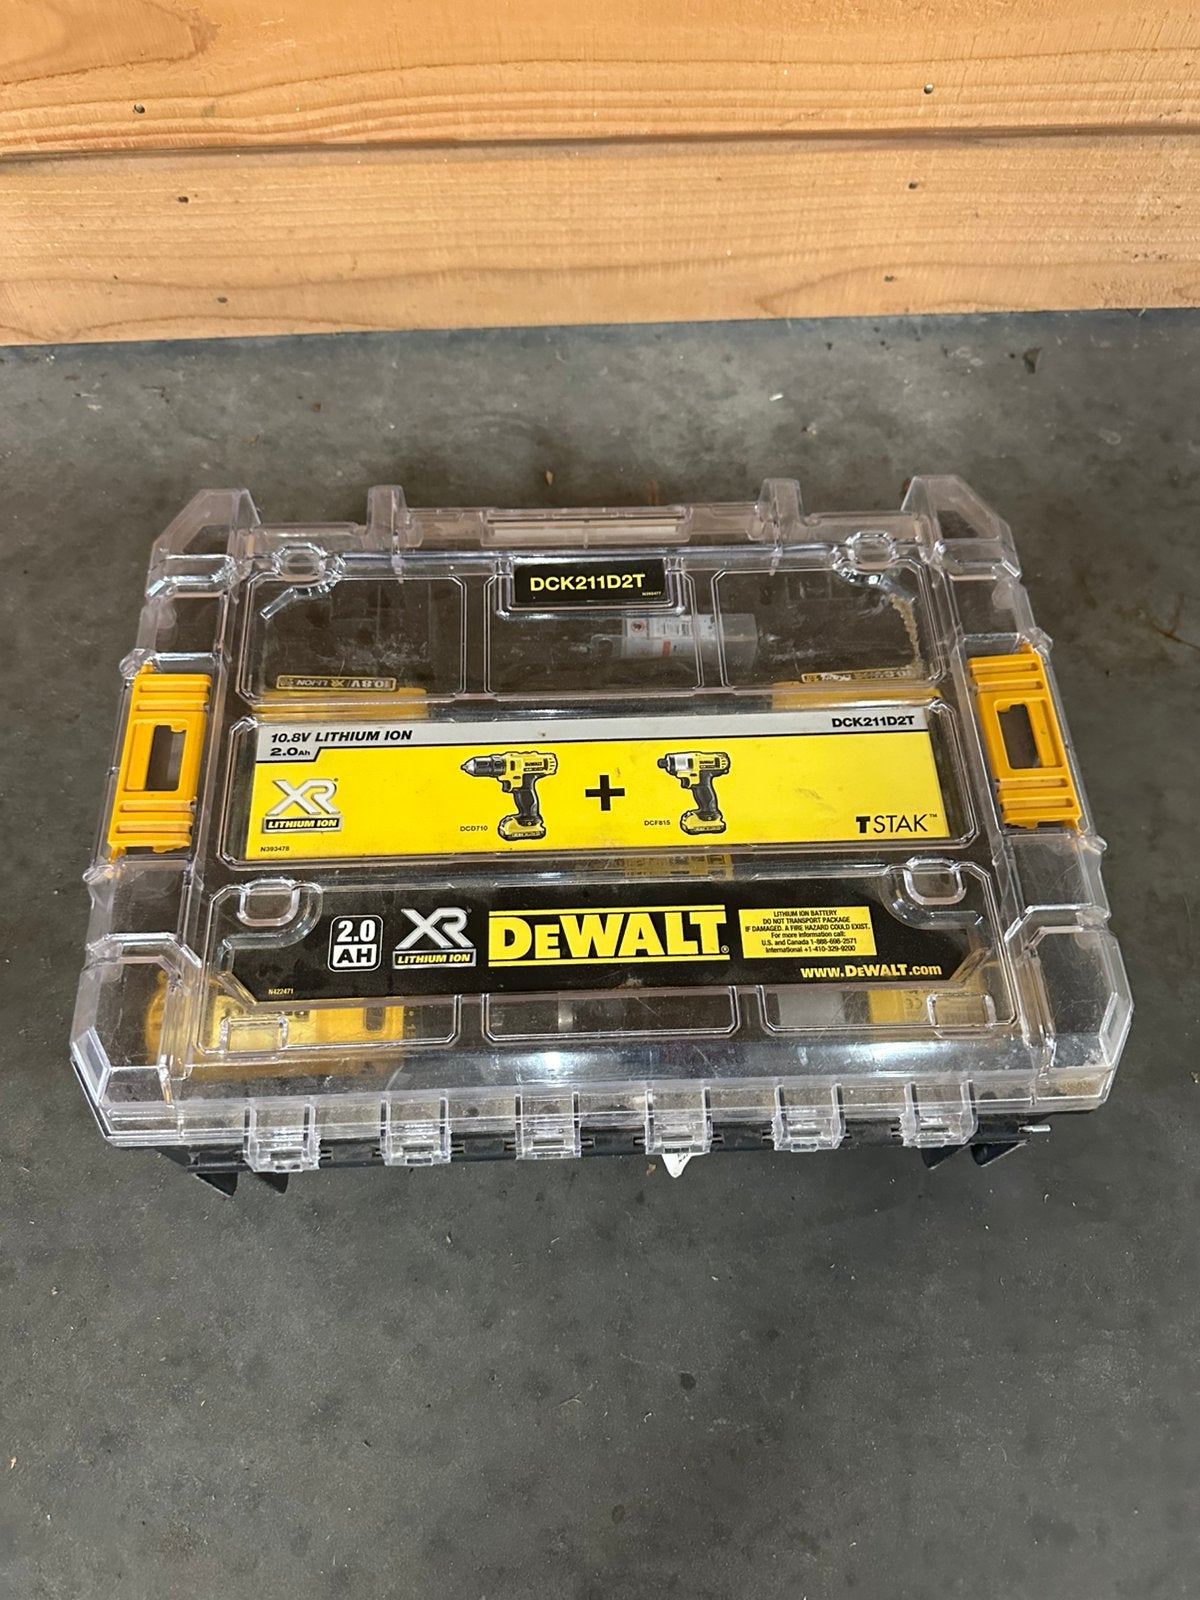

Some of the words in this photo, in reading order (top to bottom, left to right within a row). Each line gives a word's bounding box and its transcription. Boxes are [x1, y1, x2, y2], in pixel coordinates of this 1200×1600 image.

[530, 574, 646, 591] DCK211D2T
[832, 715, 915, 728] DCK211D2T
[271, 732, 310, 743] 10.8V
[315, 731, 380, 742] LITHIUM
[384, 730, 412, 740] ION
[270, 747, 310, 757] 2.0Ah
[267, 779, 340, 816] XR
[268, 819, 314, 829] LITHIUM
[316, 818, 338, 828] ION
[337, 919, 376, 942] 2.0
[396, 907, 474, 949] XR
[337, 948, 373, 964] AH
[397, 954, 447, 964] LITHIUM
[448, 953, 471, 963] ION
